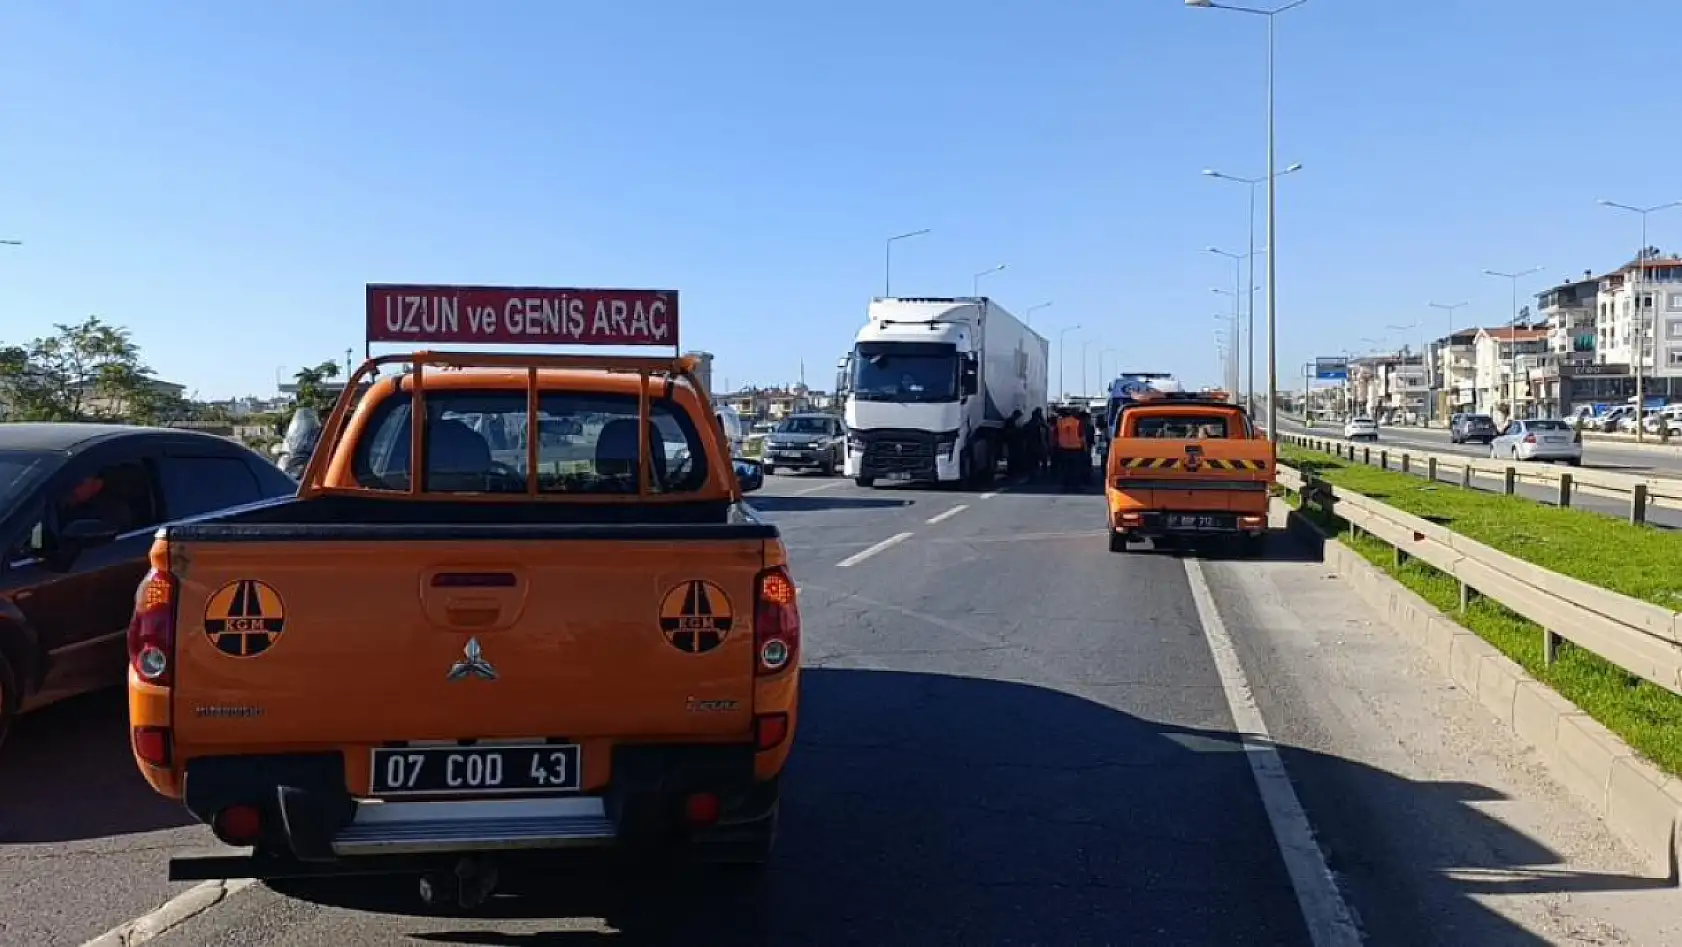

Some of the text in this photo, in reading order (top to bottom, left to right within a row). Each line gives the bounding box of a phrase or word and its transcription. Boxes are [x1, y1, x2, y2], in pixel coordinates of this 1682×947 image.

[385, 293, 667, 340] UZUN ve GENİŞ ARAÇ
[226, 619, 265, 630] KGM
[387, 752, 566, 788] 07 COD 43
